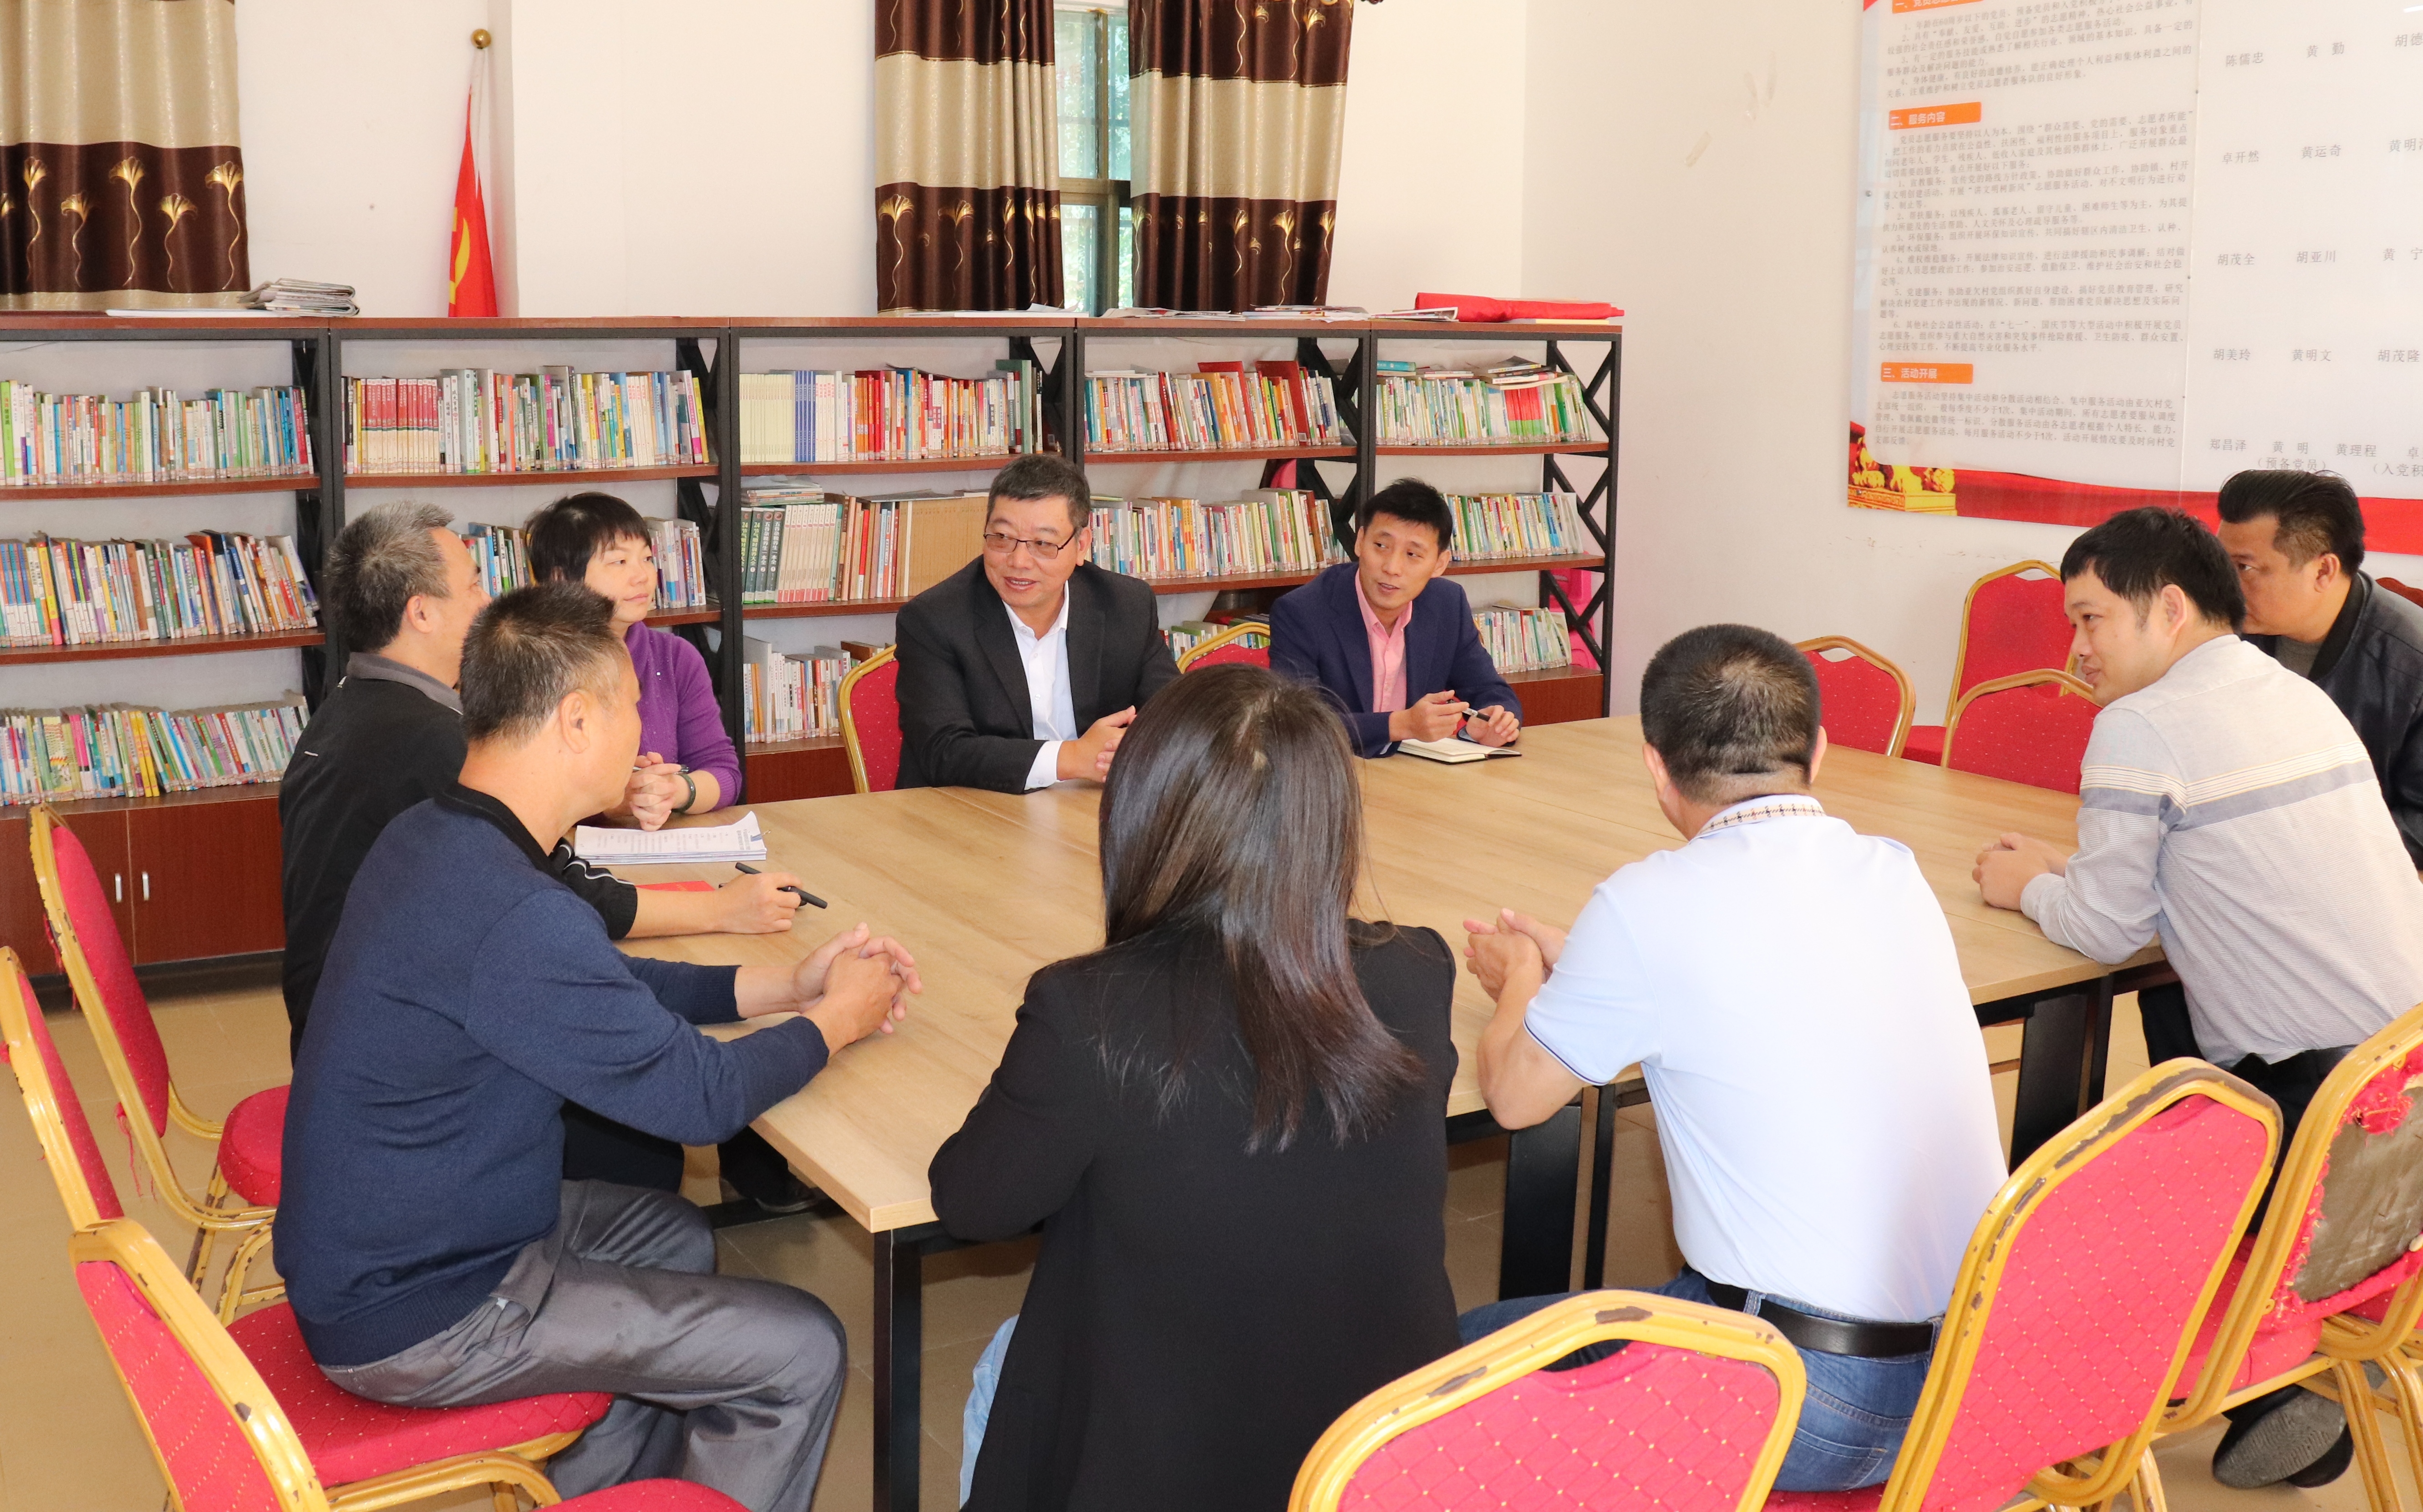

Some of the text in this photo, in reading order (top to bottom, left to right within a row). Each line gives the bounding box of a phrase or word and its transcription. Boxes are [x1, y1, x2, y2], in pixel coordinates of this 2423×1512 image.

[2226, 51, 2264, 67] 陈儒忠
[1890, 112, 1946, 127] 二、服务内容
[2222, 150, 2260, 164] 卓开然
[2301, 144, 2342, 159] 黄运奇
[2217, 253, 2255, 266] 胡茂全
[2296, 250, 2336, 264] 胡亚川
[2213, 348, 2251, 361] 胡美玲
[2292, 349, 2332, 362] 黄明文
[2377, 349, 2420, 363] 胡茂隆
[1883, 367, 1937, 380] 三、活动开展
[2209, 438, 2247, 452] 郑昌泽
[2336, 443, 2377, 457] 黄理程
